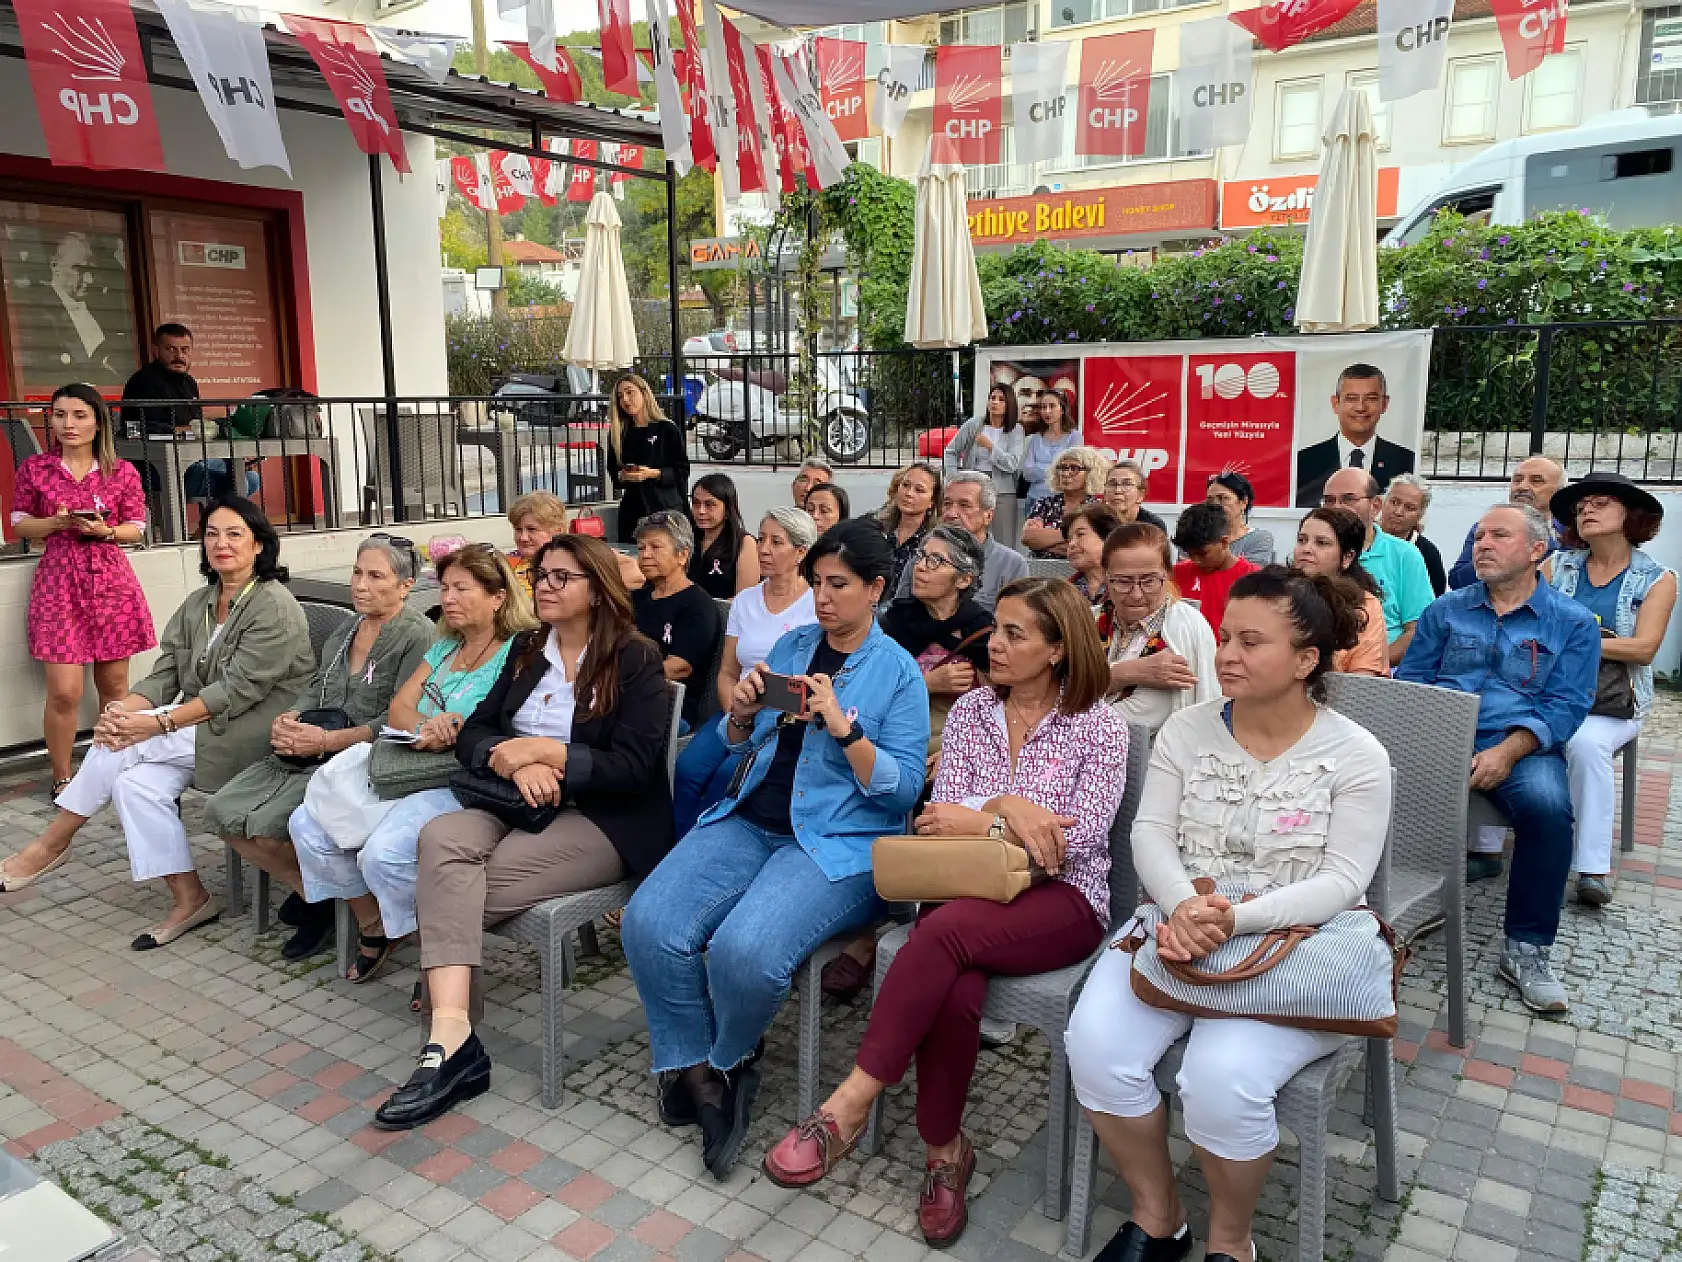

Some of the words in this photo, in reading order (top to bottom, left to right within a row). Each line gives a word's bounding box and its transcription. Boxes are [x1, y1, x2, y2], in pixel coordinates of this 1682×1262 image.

[1396, 17, 1449, 52] CHP
[1193, 82, 1245, 107] CHP
[825, 96, 862, 121] CHP
[1029, 95, 1066, 122] CHP
[1088, 107, 1139, 129] CHP
[945, 119, 992, 139] CHP
[968, 205, 1029, 238] ethiye
[1035, 197, 1105, 232] Balevi
[208, 249, 239, 264] CHP
[1195, 362, 1280, 400] 100
